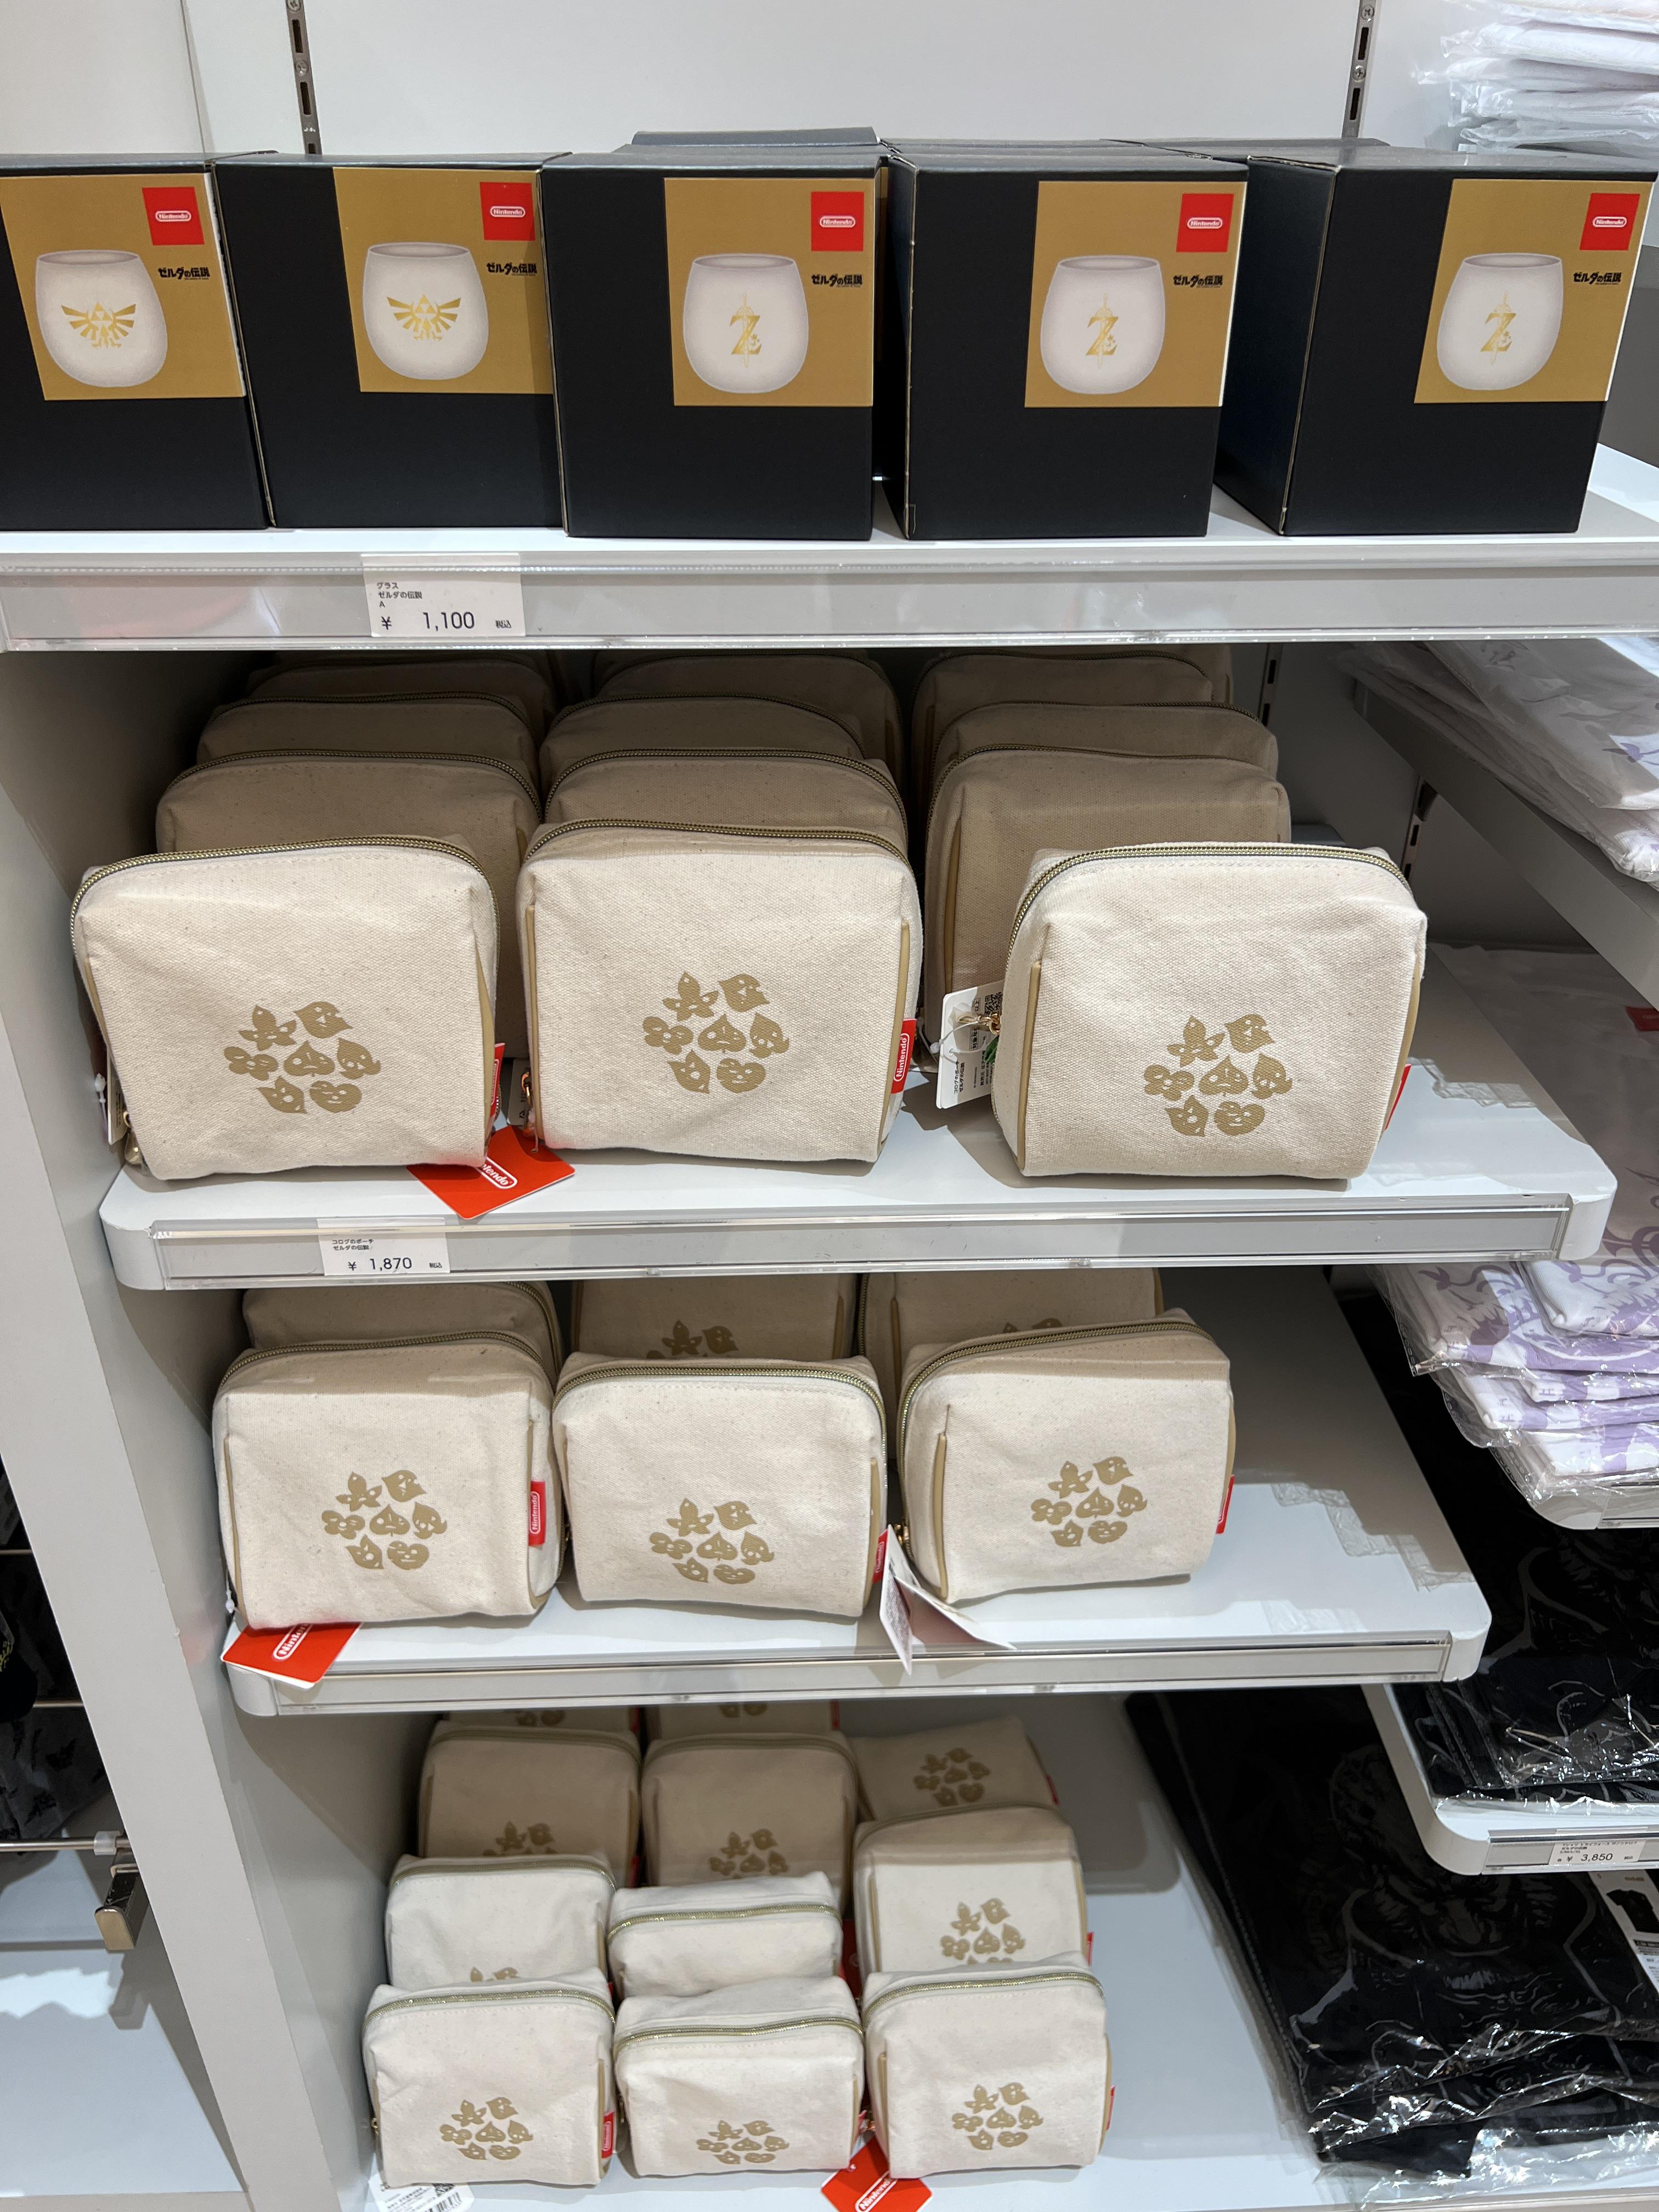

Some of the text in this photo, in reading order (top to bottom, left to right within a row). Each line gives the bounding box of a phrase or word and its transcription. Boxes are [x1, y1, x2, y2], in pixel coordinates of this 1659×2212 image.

[158, 267, 210, 279] ゼルダの伝説
[487, 262, 537, 275] ゼルダの伝説
[811, 274, 862, 286] ゼルダの伝説
[1173, 275, 1223, 287] ゼルダの伝説
[1573, 272, 1622, 284] ゼルダの伝説
[422, 612, 475, 631] 1,100
[896, 1037, 907, 1077] Nintendo
[483, 1164, 508, 1185] tendo
[370, 1257, 412, 1271] 1,870
[1581, 1853, 1613, 1862] 3,850
